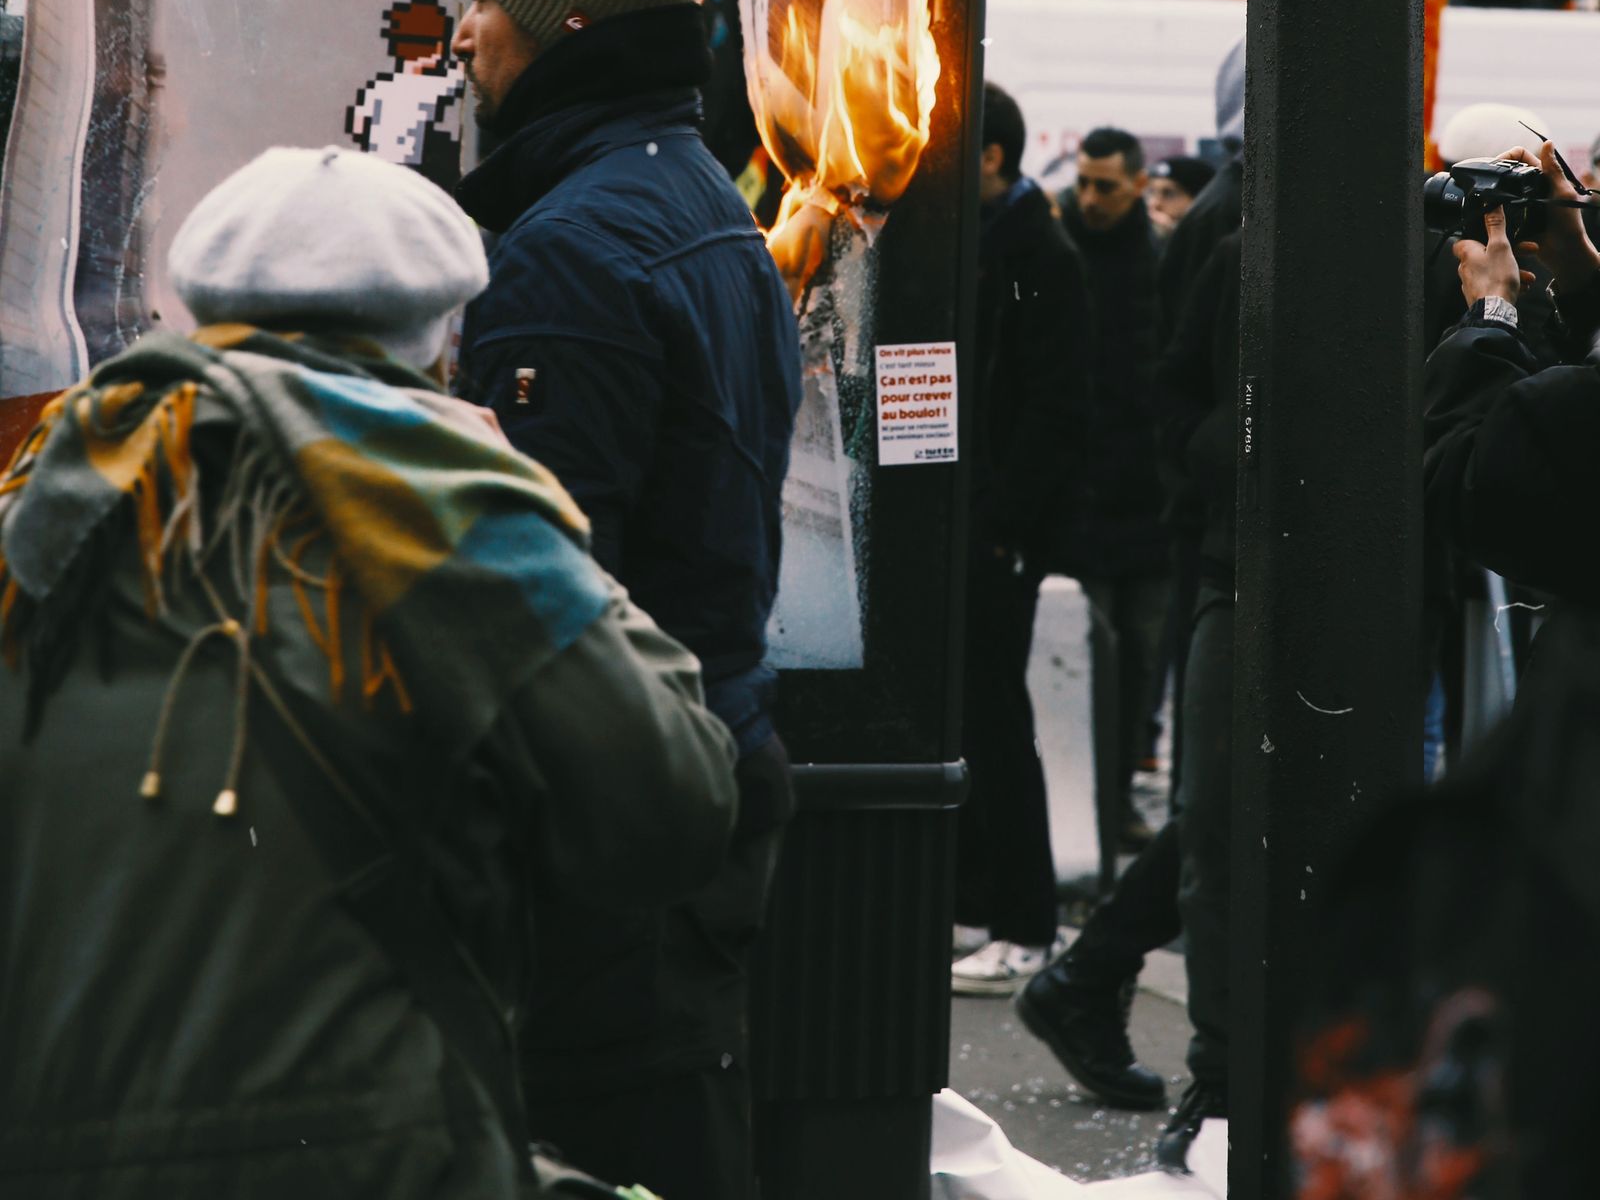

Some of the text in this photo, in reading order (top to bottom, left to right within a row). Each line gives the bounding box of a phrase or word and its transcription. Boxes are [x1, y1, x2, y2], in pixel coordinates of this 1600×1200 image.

[879, 349, 892, 357] On
[907, 348, 925, 358] plus
[927, 347, 951, 355] vieux
[880, 374, 952, 387] Ça n'est pas
[881, 390, 952, 405] pour crever
[882, 410, 896, 420] au
[899, 407, 941, 419] boulot
